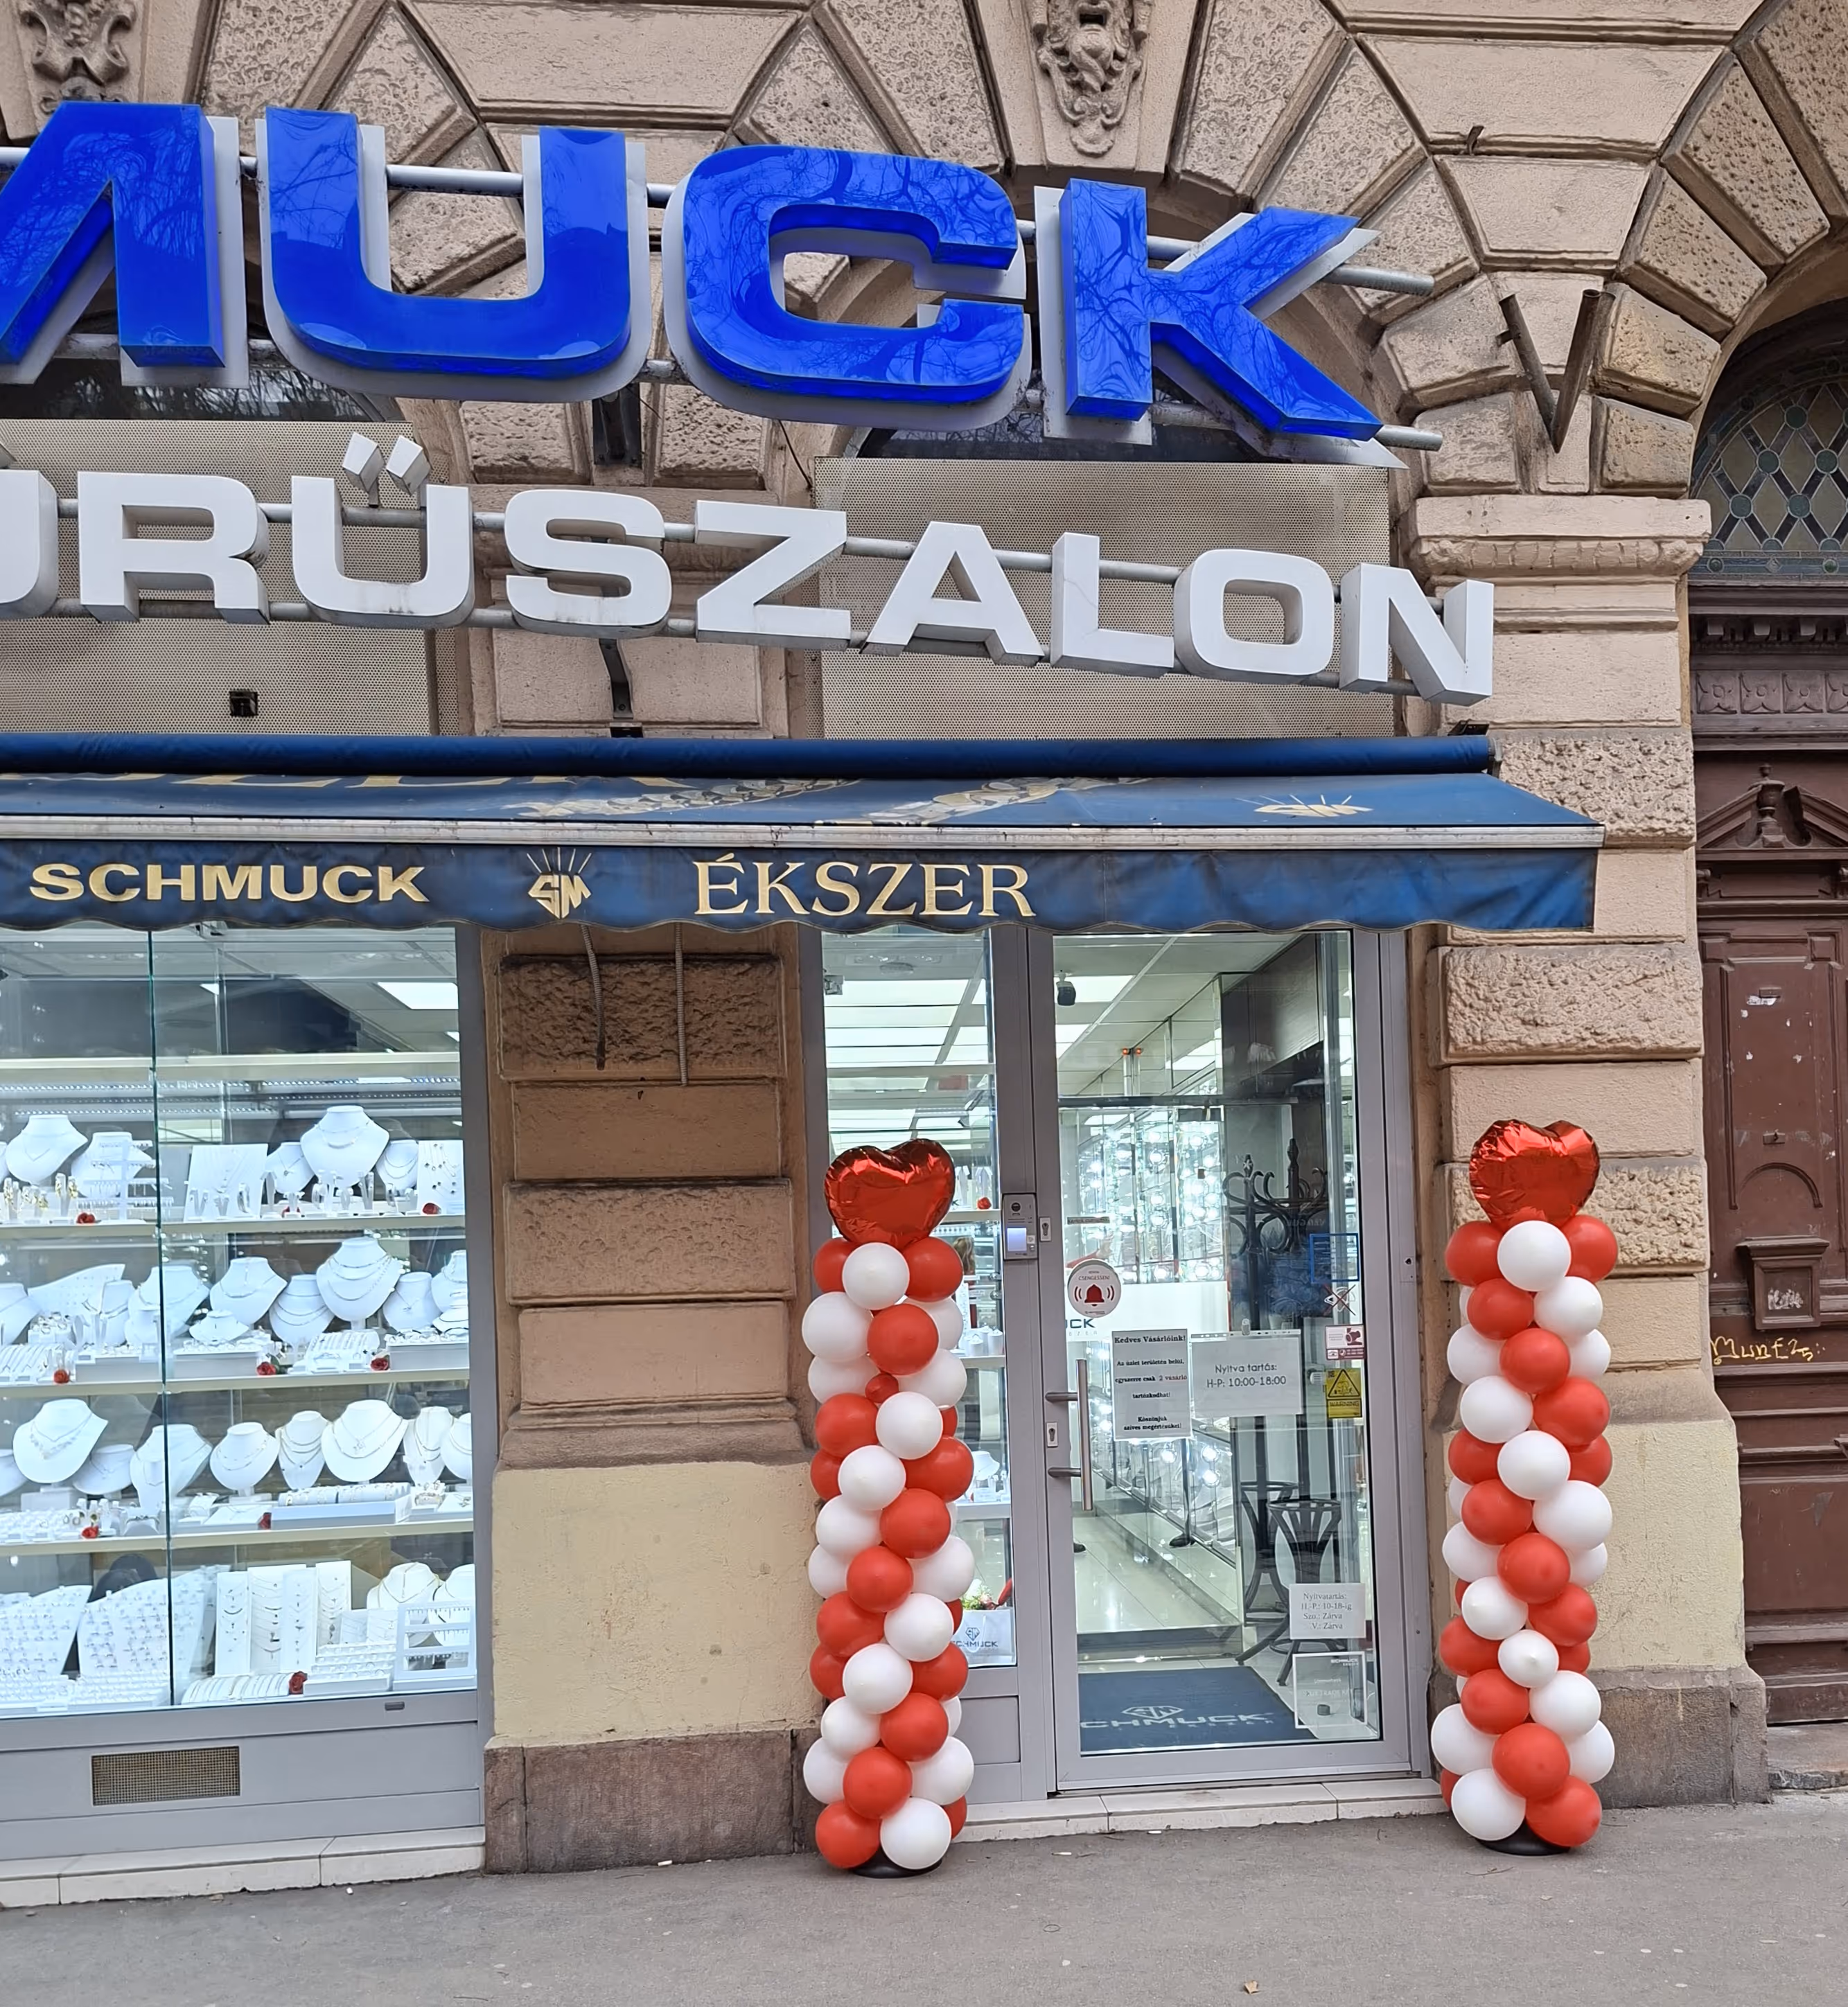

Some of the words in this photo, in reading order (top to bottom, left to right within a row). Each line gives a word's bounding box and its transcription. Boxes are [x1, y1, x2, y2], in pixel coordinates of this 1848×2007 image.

[29, 863, 430, 904] SCHMUCK
[694, 852, 1037, 918] ÉKSZER
[1143, 1334, 1186, 1343] Vásárlóink!
[1215, 1363, 1245, 1375] Nyitva
[1247, 1362, 1278, 1372] tartás:
[1206, 1378, 1226, 1388] H-P:
[1229, 1375, 1287, 1387] 10:00-18:00
[1303, 1591, 1347, 1602] Nyitvatartás:
[1323, 1602, 1353, 1611] 10-18-ig
[1323, 1611, 1343, 1620] Zárva
